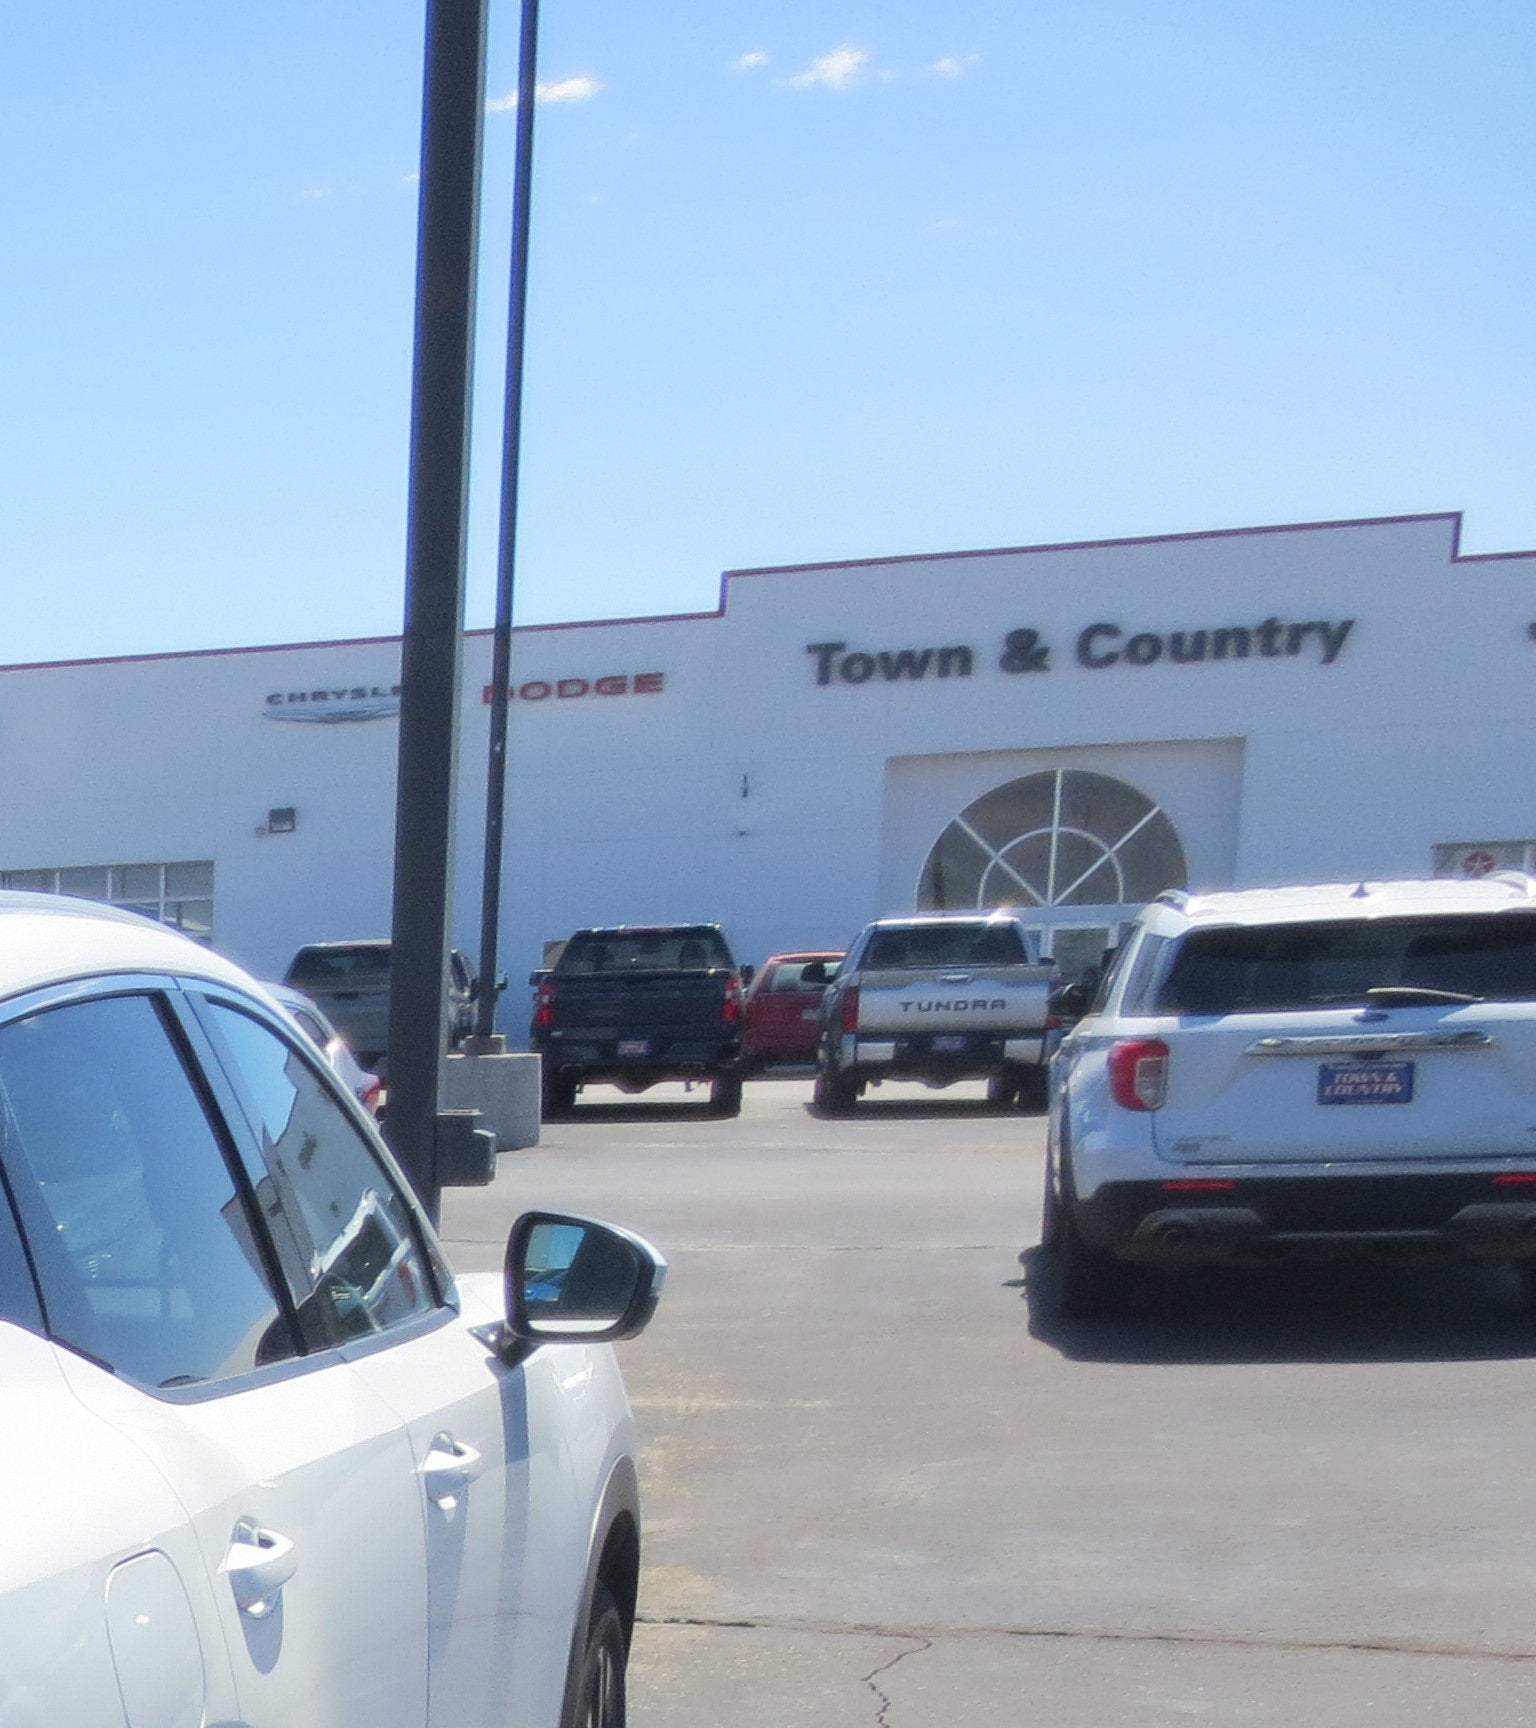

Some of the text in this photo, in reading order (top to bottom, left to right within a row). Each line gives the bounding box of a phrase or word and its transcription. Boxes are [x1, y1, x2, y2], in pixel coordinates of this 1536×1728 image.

[806, 617, 1356, 686] Town & Country
[900, 999, 1007, 1013] TUNDRA
